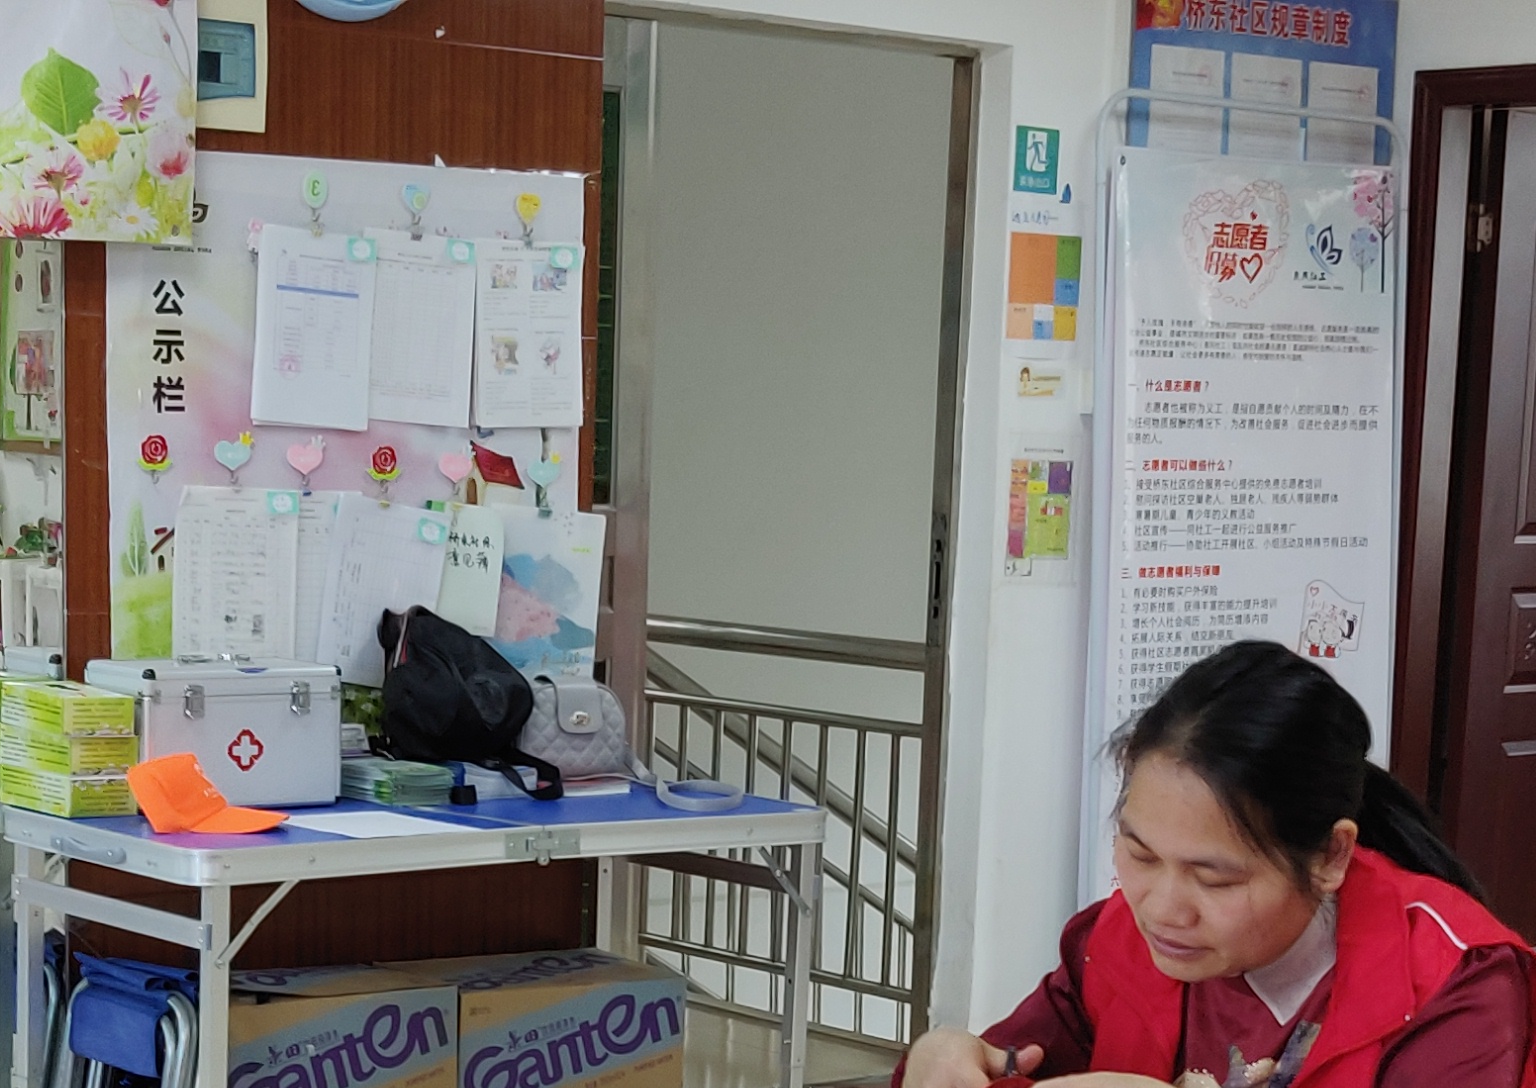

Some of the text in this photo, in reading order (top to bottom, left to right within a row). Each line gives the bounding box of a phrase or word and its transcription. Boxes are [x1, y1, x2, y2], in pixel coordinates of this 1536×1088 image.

[1186, 0, 1352, 46] 桥东社区规章制度
[1214, 222, 1270, 250] 志愿者
[152, 280, 186, 414] 公示栏
